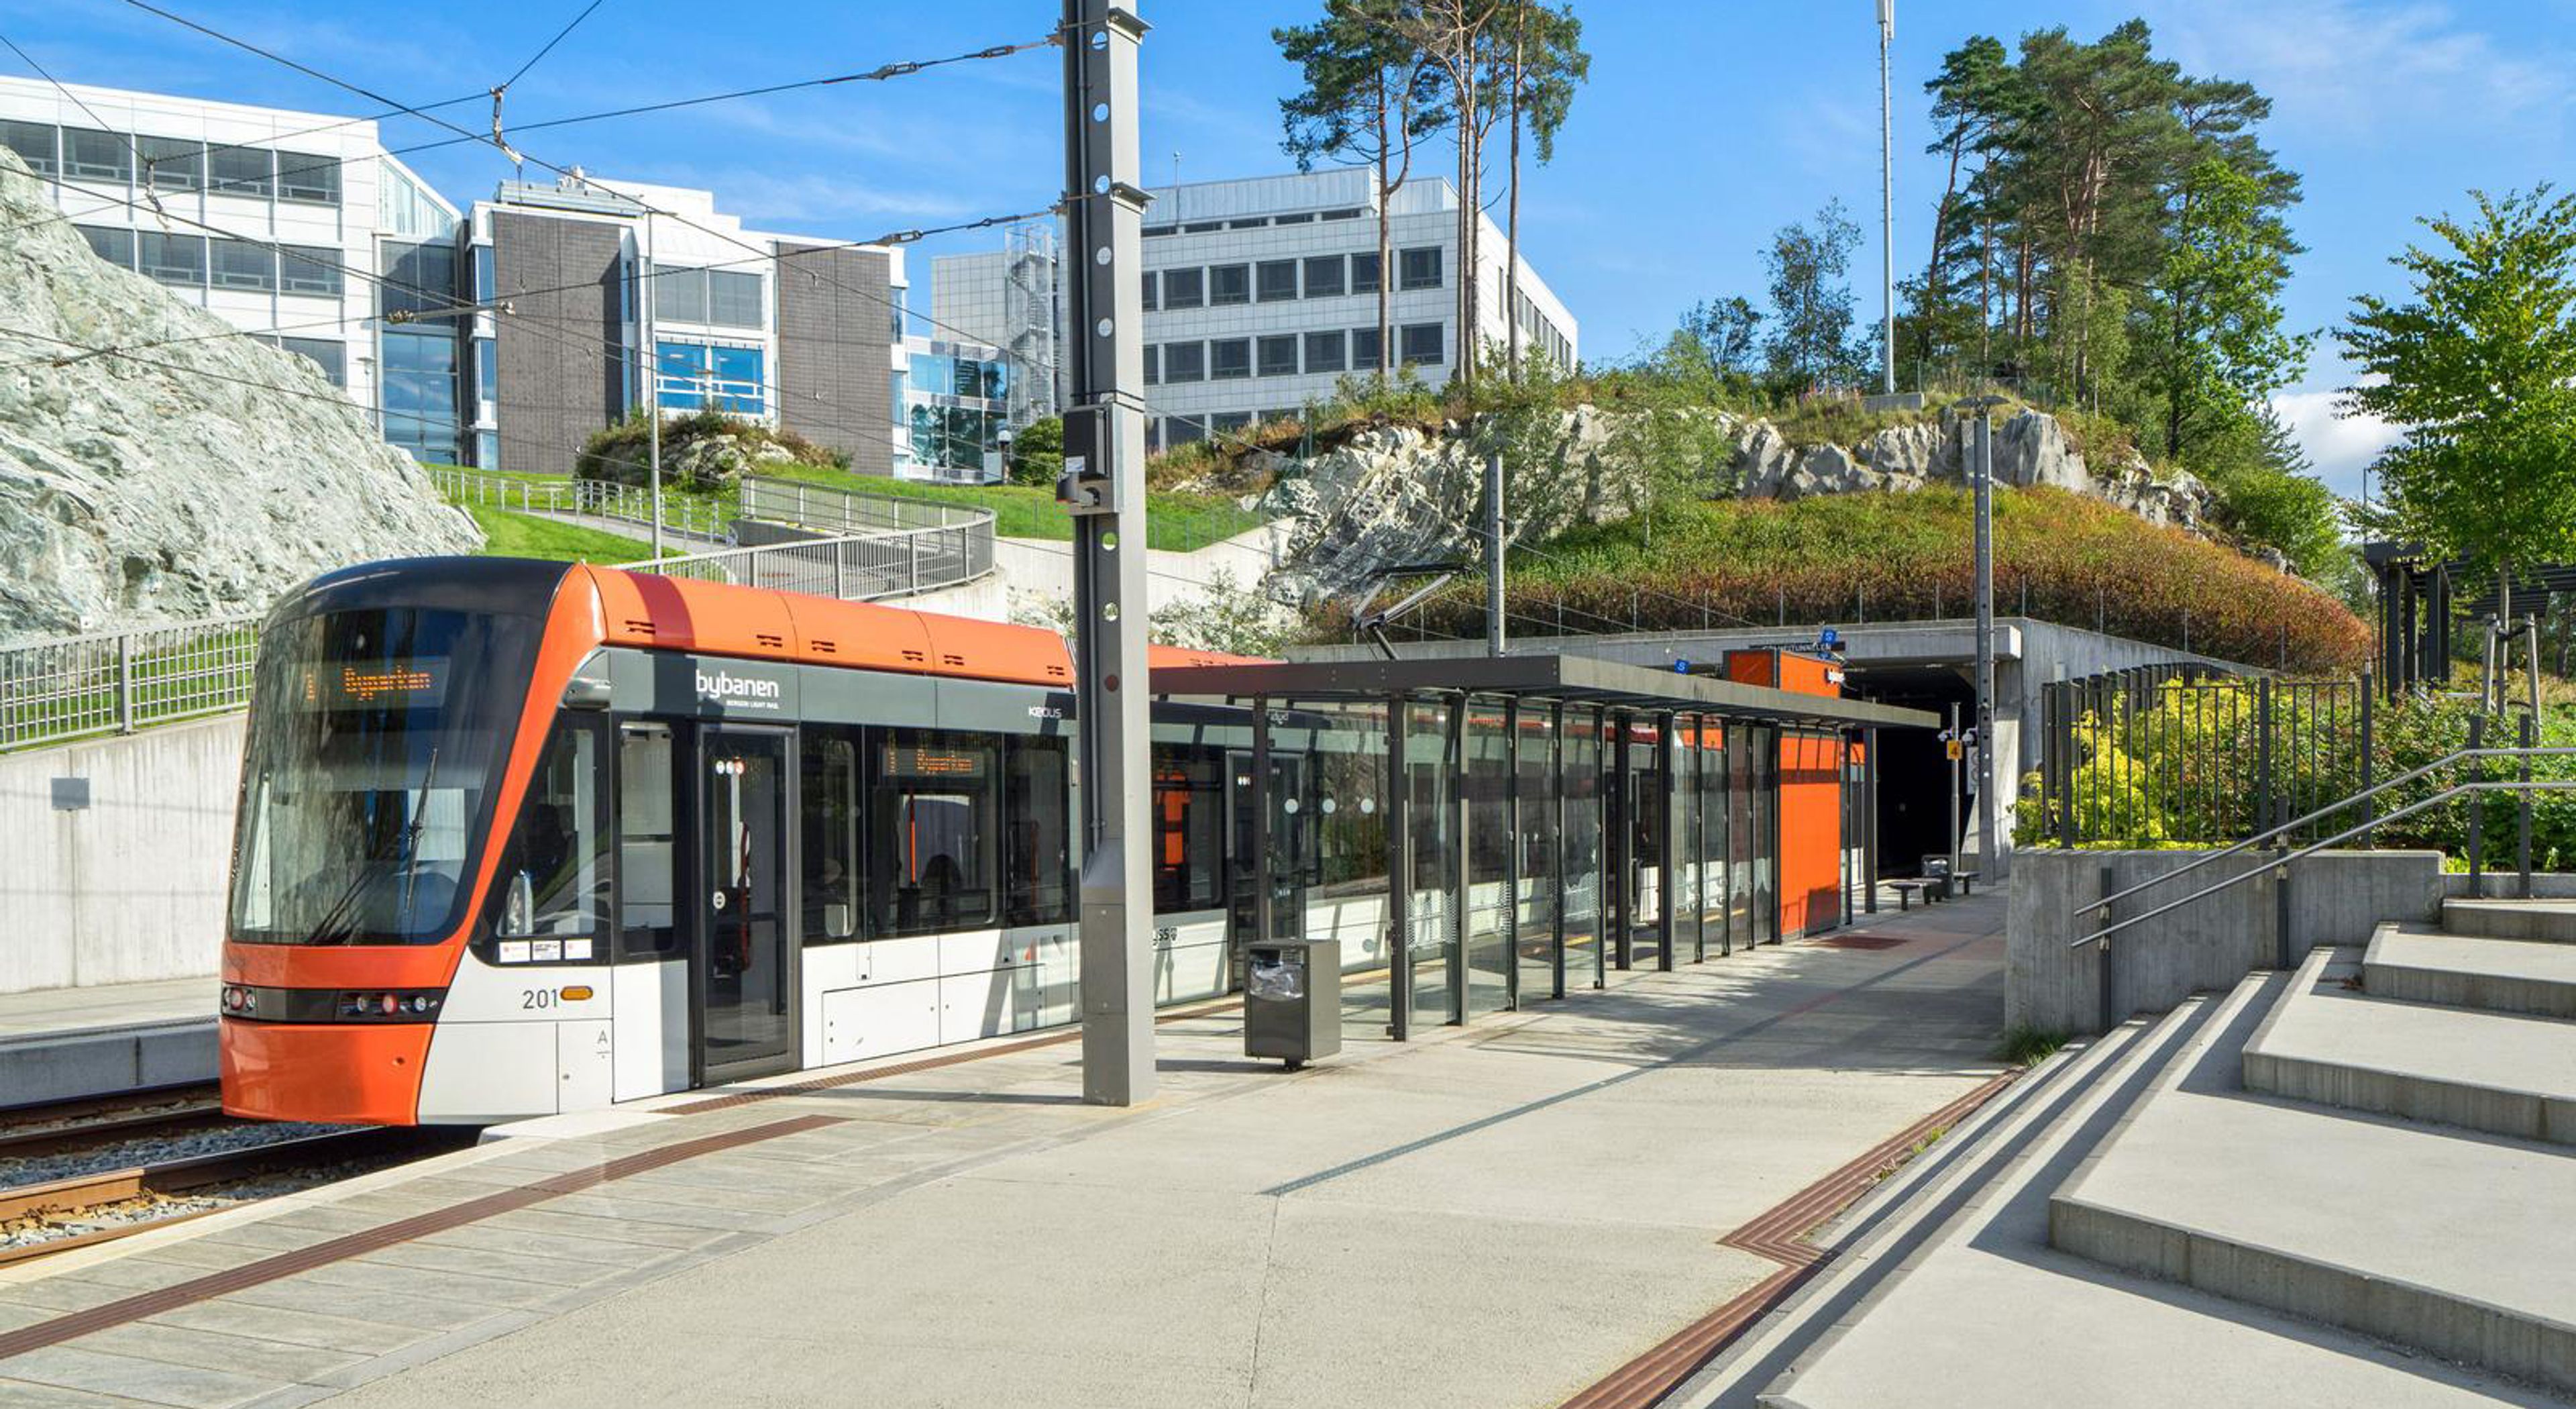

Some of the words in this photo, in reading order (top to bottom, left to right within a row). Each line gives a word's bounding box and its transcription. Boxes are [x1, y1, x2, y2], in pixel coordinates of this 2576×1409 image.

[696, 668, 779, 699] bybanen
[522, 989, 557, 1010] 201
[596, 1029, 608, 1045] A
